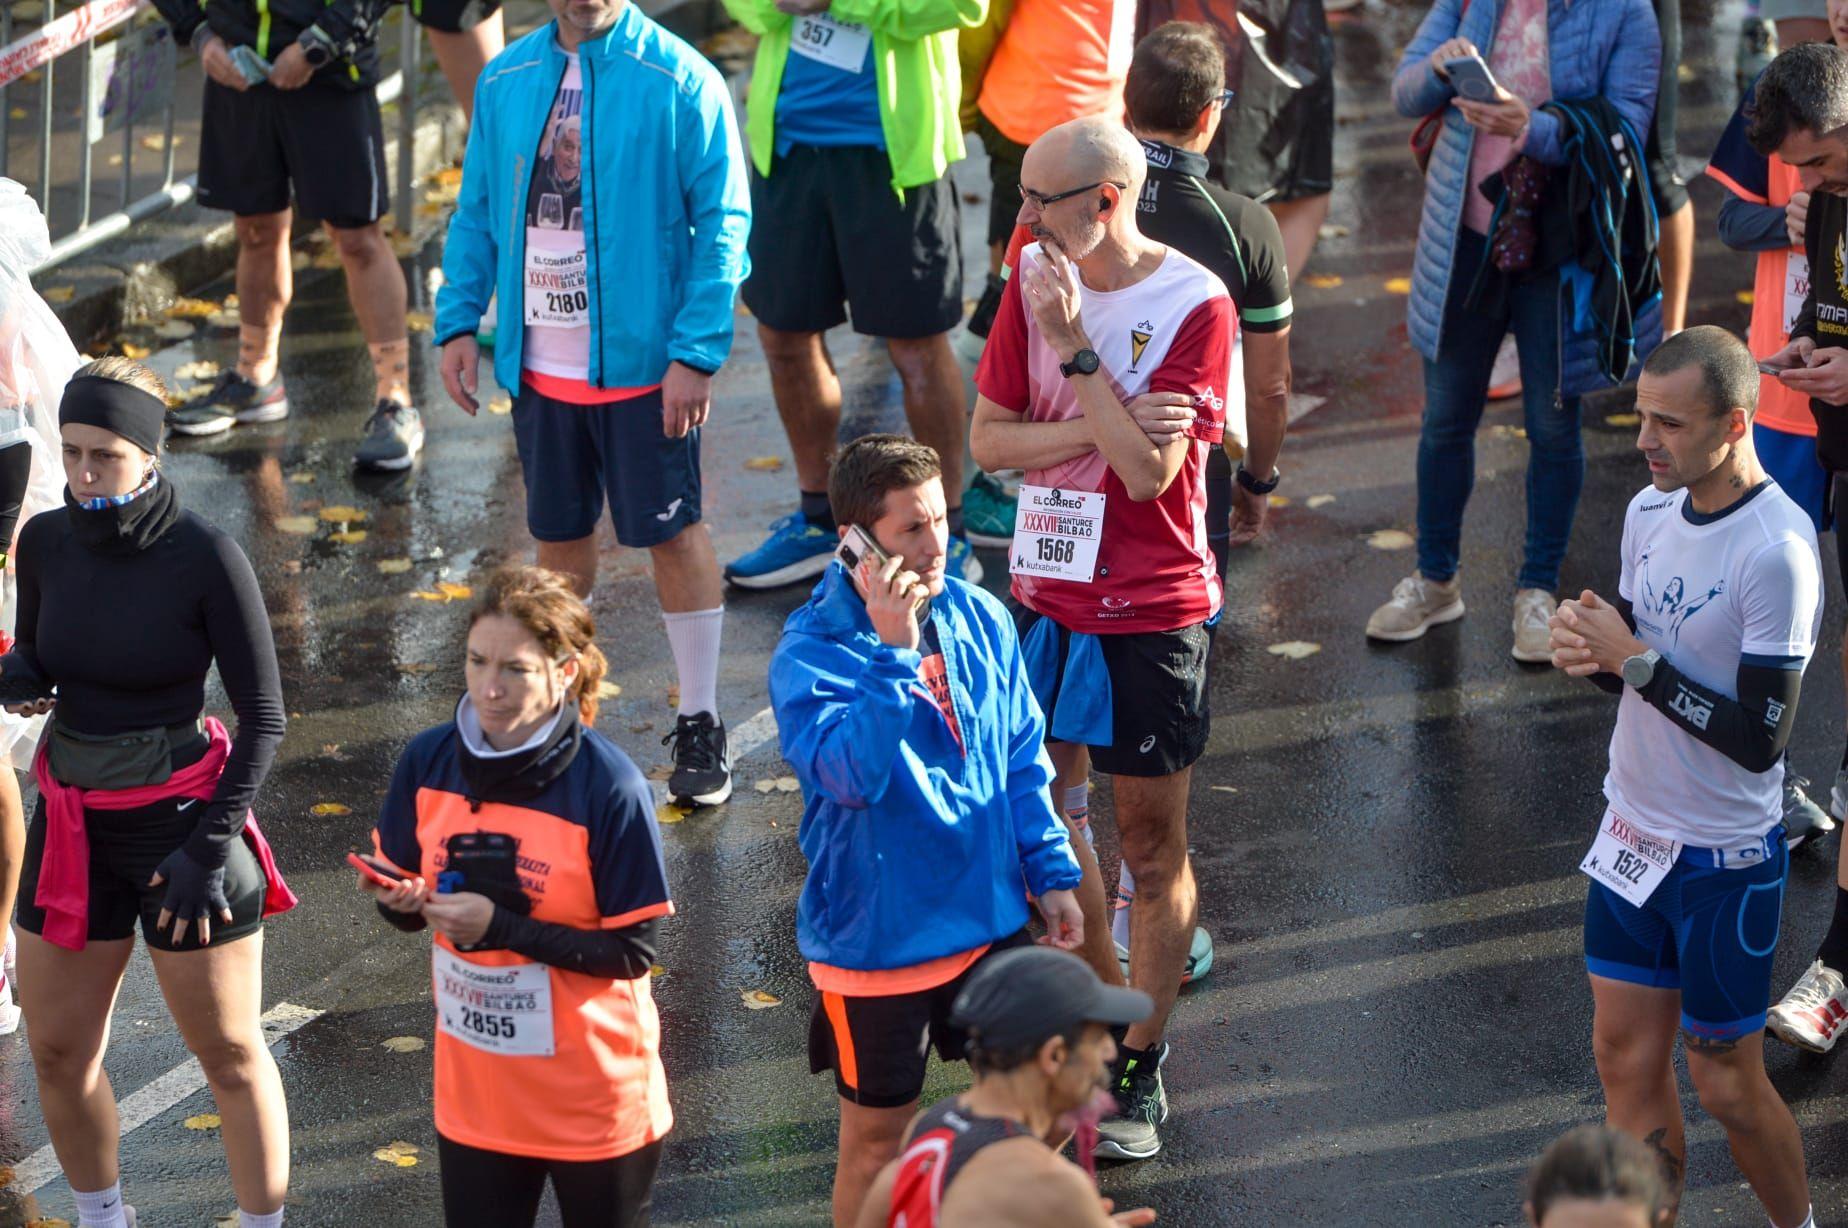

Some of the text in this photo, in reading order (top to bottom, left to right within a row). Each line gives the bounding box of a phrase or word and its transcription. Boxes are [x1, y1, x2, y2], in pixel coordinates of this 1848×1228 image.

[801, 20, 835, 47] 357
[546, 290, 588, 313] 2180
[1033, 495, 1082, 510] EL CORREO
[1057, 516, 1094, 528] SANTURCE
[1057, 524, 1093, 537] BILBAO
[1036, 537, 1075, 564] 1568
[1026, 561, 1062, 572] kutxabank
[1668, 691, 1713, 731] BKT
[1637, 843, 1668, 866] BILBAO
[1612, 848, 1649, 885] 1522
[460, 1004, 516, 1039] 2855
